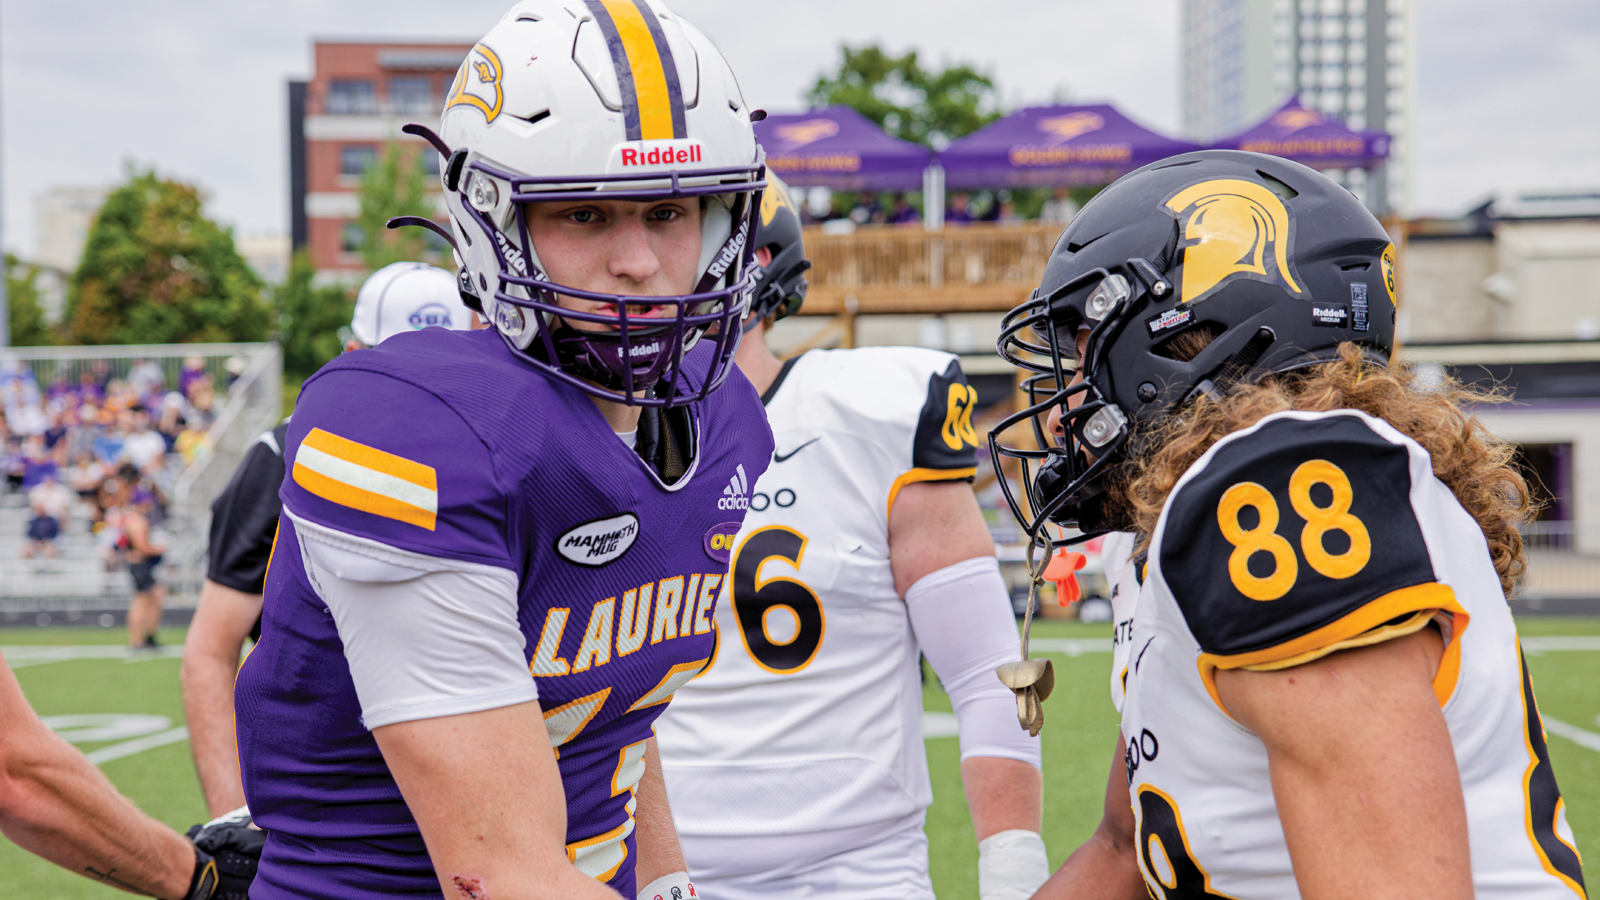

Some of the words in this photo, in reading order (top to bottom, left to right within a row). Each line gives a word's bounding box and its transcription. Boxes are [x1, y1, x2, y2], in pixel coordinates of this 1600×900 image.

[621, 144, 702, 166] Riddell
[707, 220, 749, 279] Riddell
[1312, 307, 1347, 317] Riddell
[564, 521, 636, 548] MAMMOTH
[1216, 459, 1372, 602] 88
[586, 540, 620, 558] MUG
[529, 573, 729, 678] LAURIE
